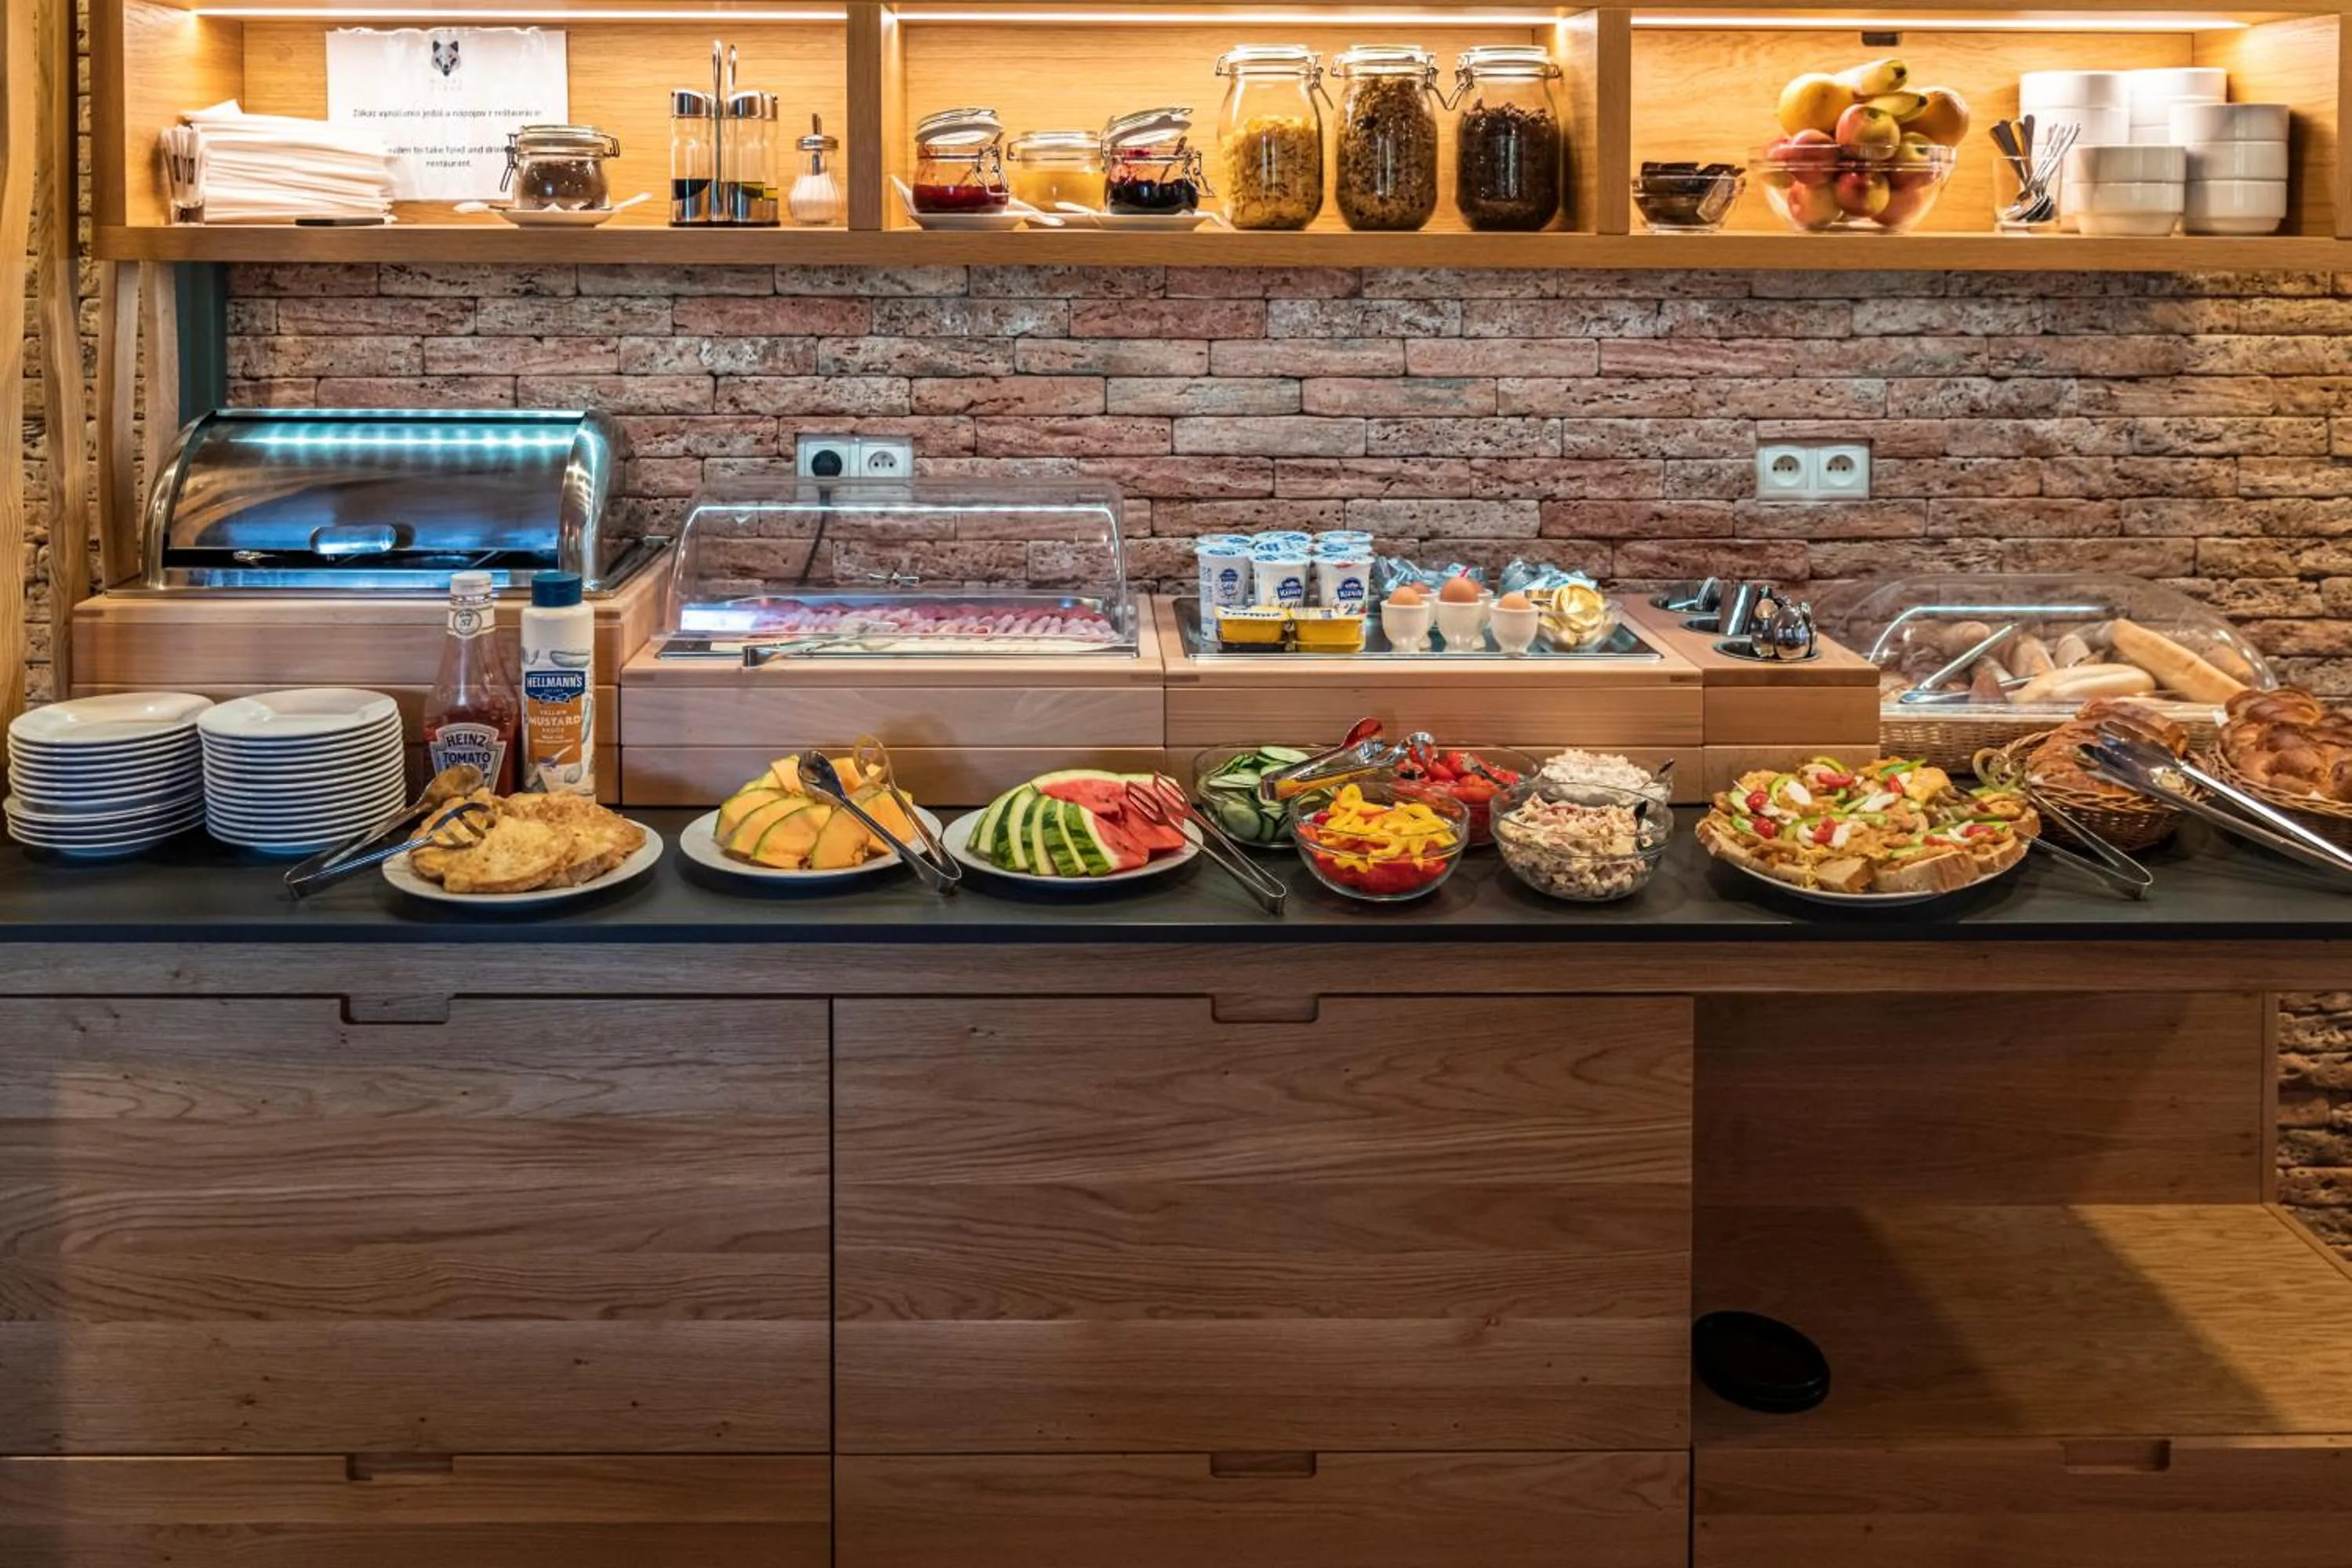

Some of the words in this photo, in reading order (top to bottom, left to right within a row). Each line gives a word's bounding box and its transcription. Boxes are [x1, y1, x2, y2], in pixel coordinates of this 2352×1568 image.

[526, 674, 583, 688] HELLMANN'S
[528, 714, 582, 727] MUSTARD
[446, 733, 487, 747] HEINZ
[442, 752, 492, 764] TOMATO
